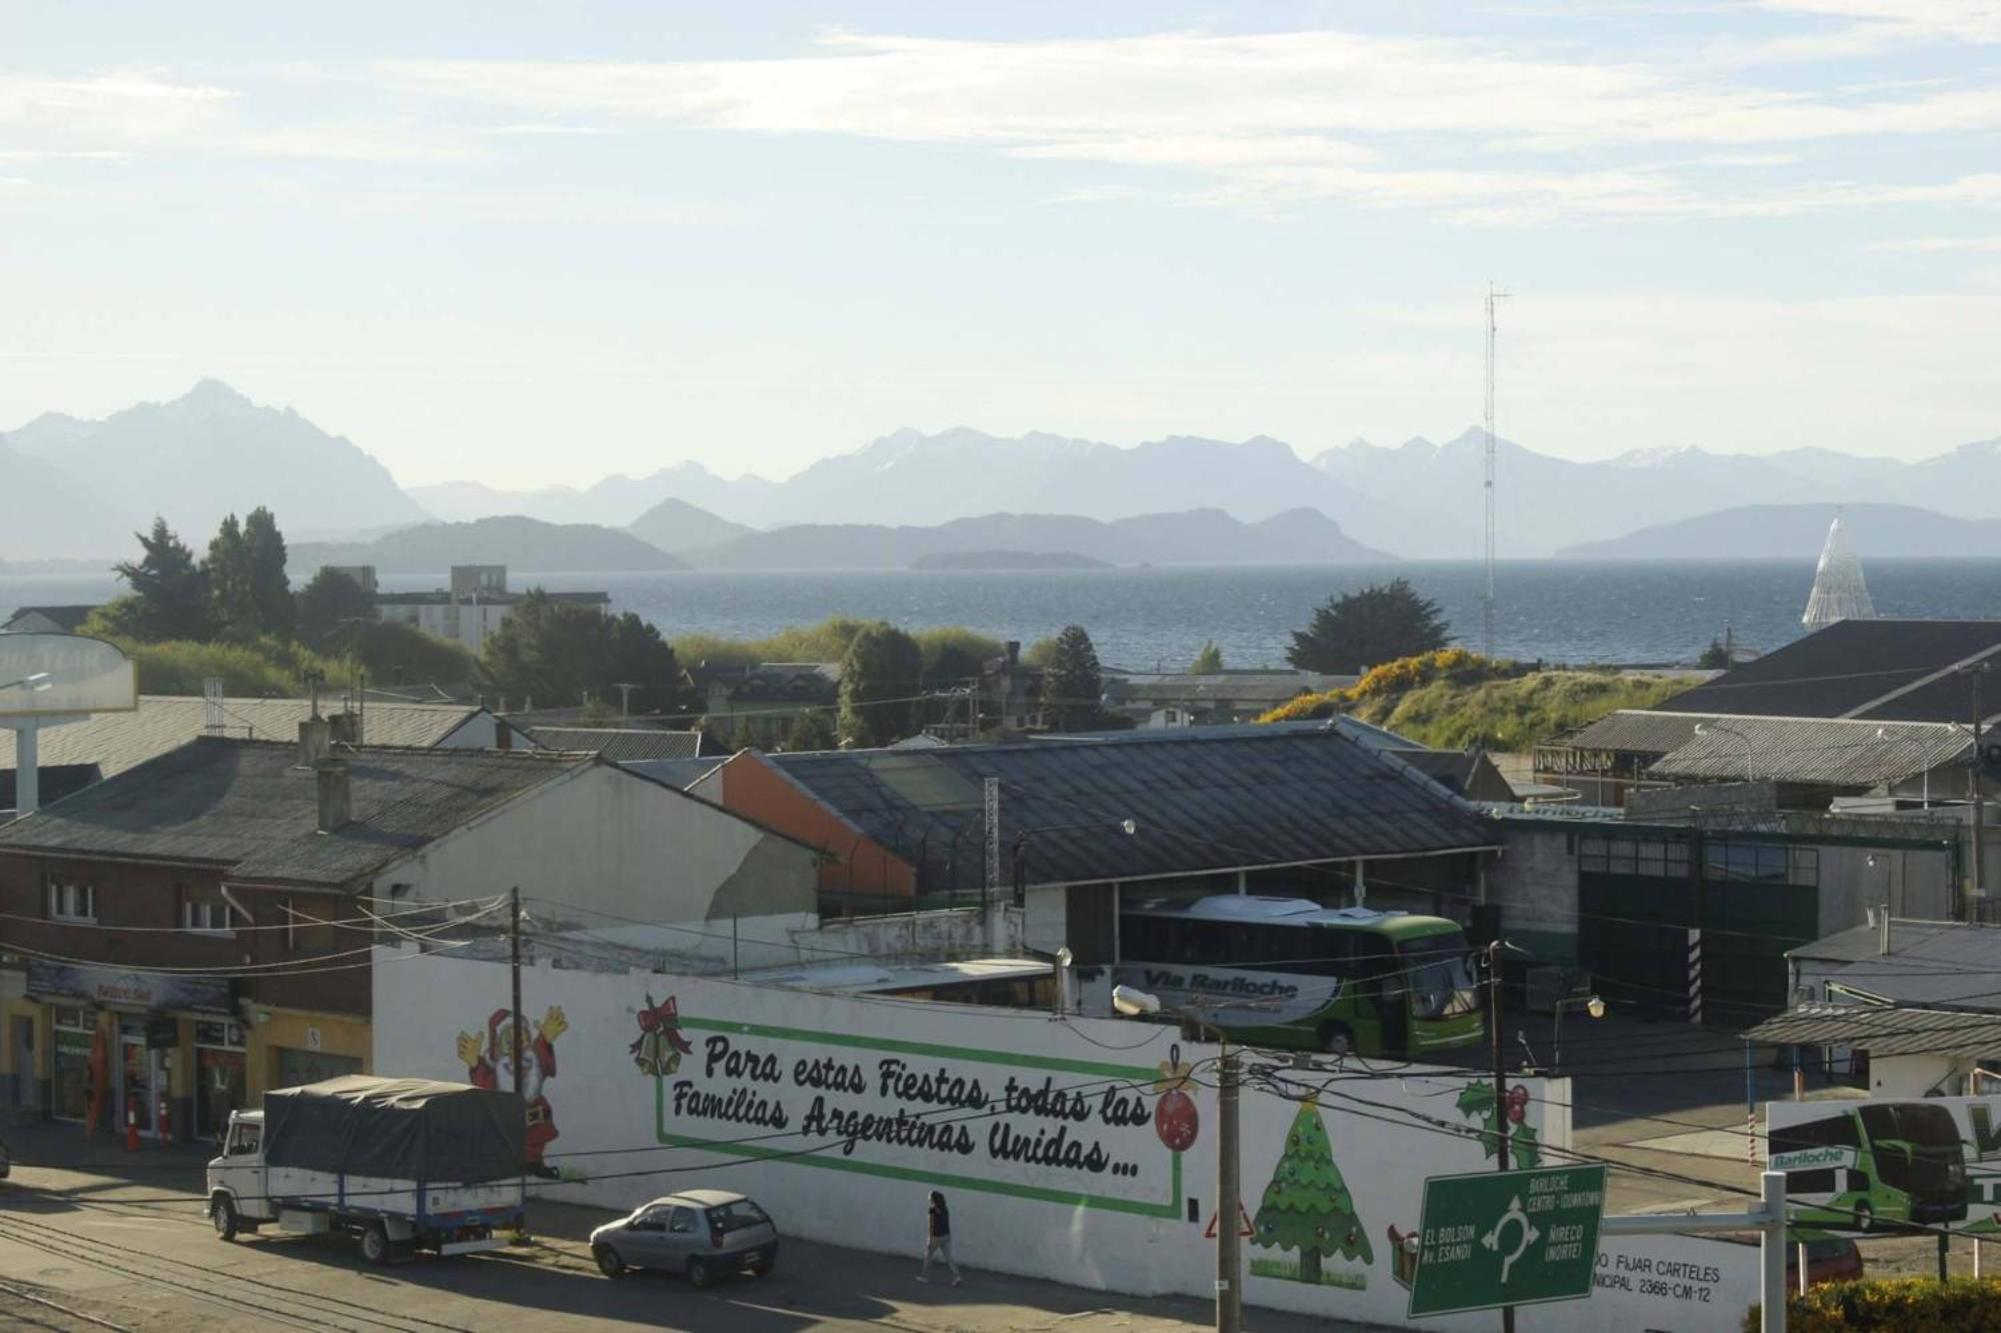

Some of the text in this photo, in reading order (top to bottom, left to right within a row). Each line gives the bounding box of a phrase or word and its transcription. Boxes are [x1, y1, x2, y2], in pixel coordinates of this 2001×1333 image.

[705, 1035, 781, 1084] Para
[793, 1056, 867, 1095] estas
[1005, 1076, 1093, 1122] todas
[1098, 1085, 1151, 1127] las
[673, 1080, 1139, 1177] Familias Argentinas Unidas...
[1774, 1147, 1844, 1167] Bariloche
[1529, 1174, 1569, 1195] BARILOCHE
[1526, 1194, 1556, 1212] CENTRO
[1424, 1223, 1476, 1246] EL BOLSON
[1438, 1244, 1472, 1263] ESANDI
[1615, 1254, 1652, 1273] FIJAR
[1656, 1260, 1720, 1284] CARTELES
